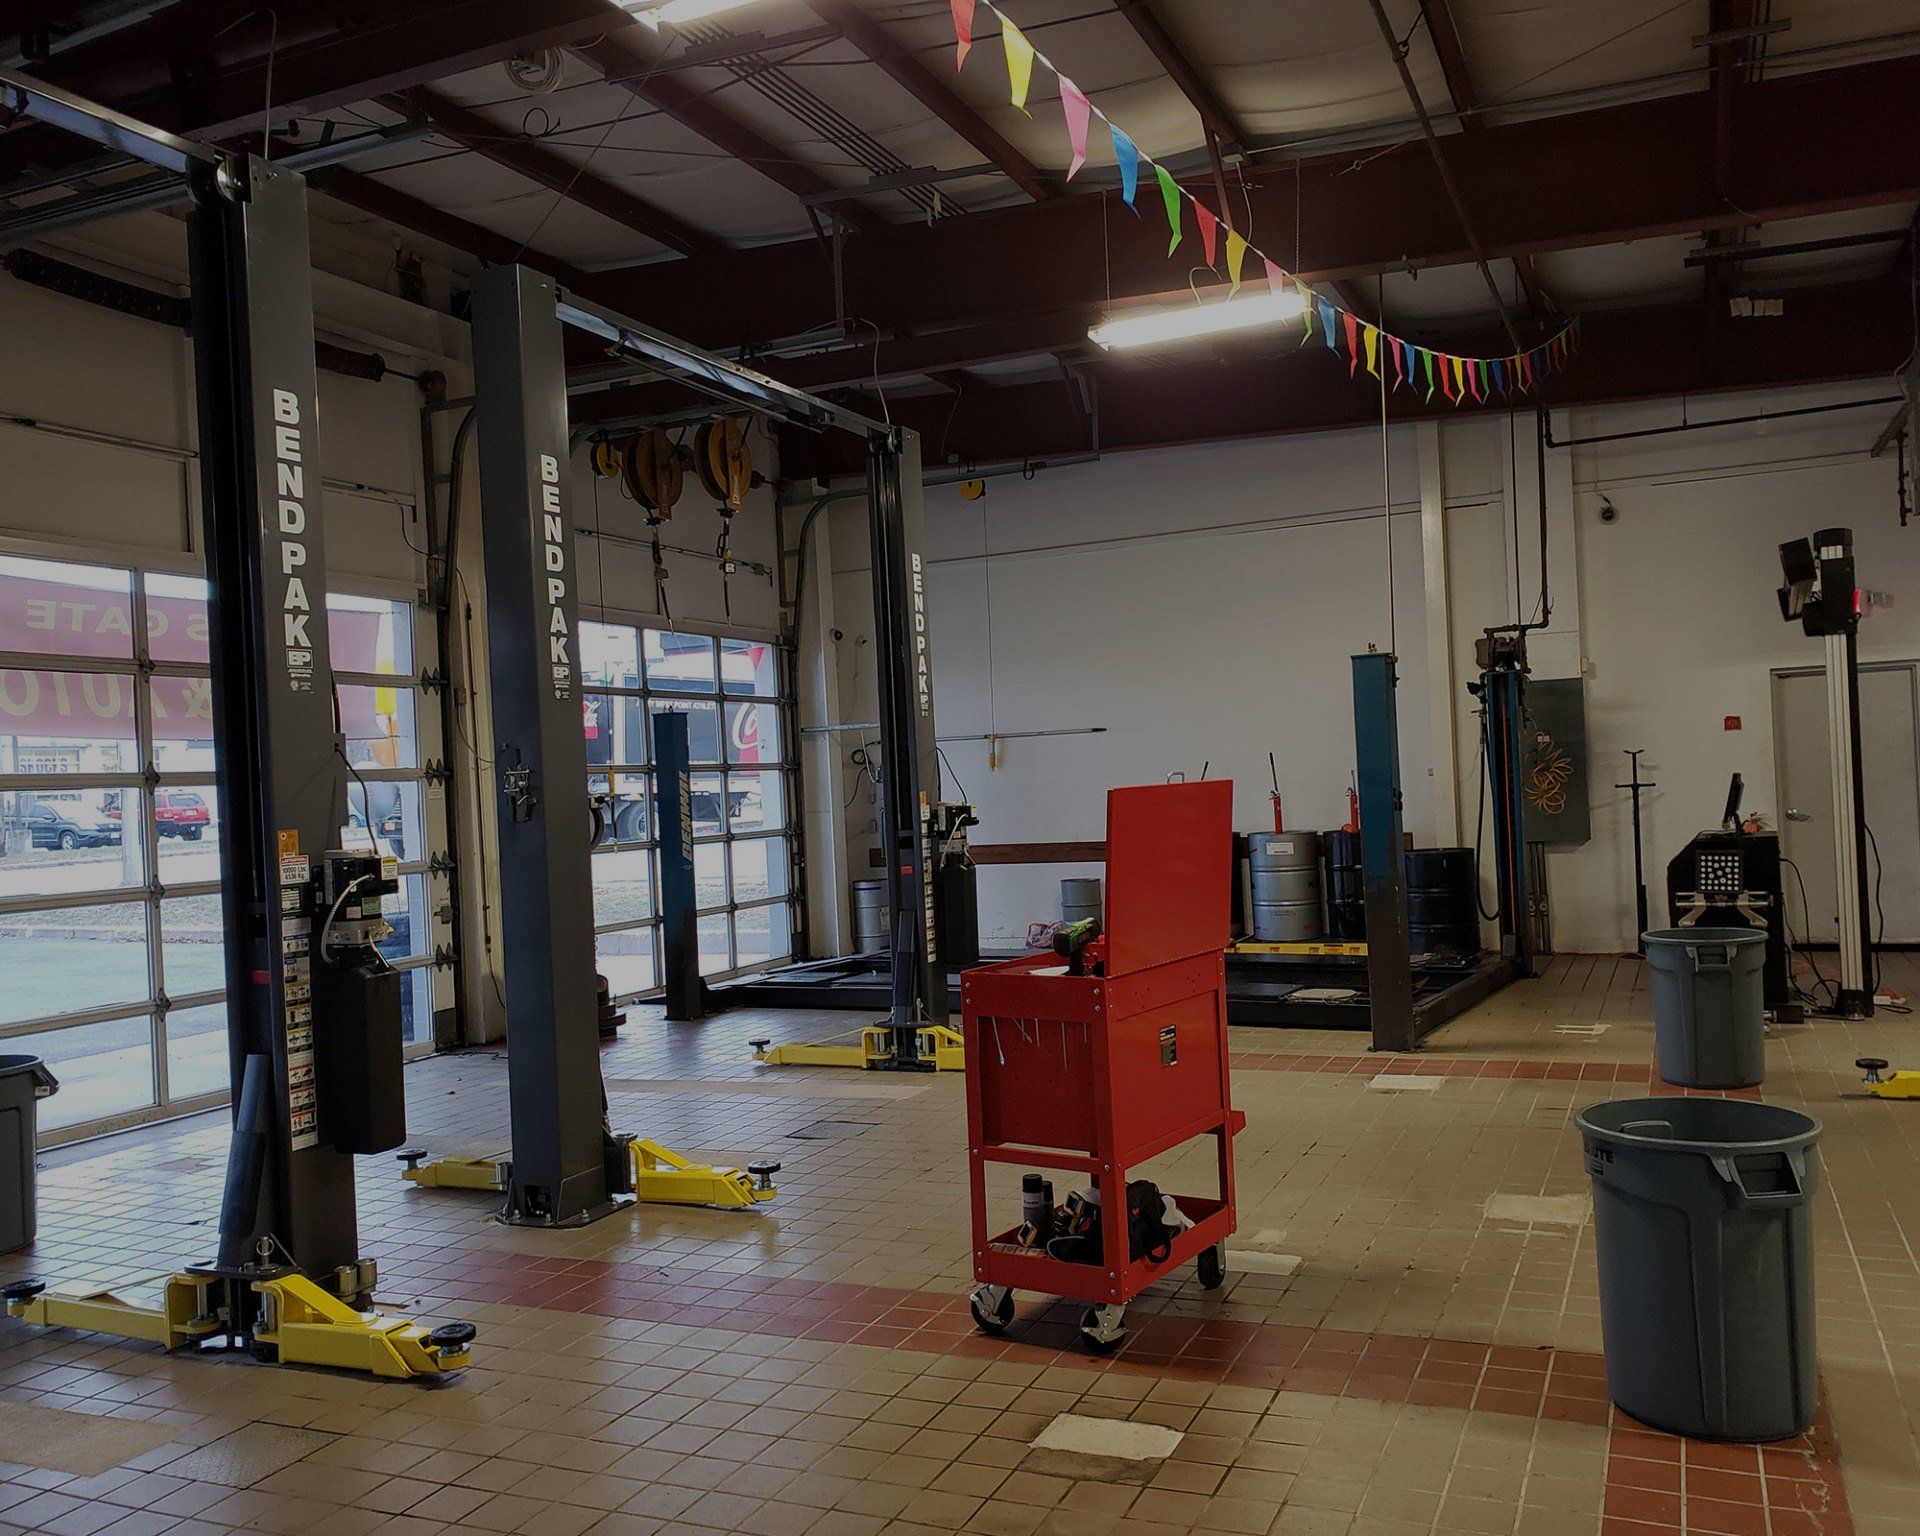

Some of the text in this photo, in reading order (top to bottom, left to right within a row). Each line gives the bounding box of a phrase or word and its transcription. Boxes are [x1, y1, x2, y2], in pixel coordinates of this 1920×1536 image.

[273, 388, 312, 647] BENDPAK
[540, 454, 570, 664] BENDPAK
[911, 553, 928, 693] BENDPAK
